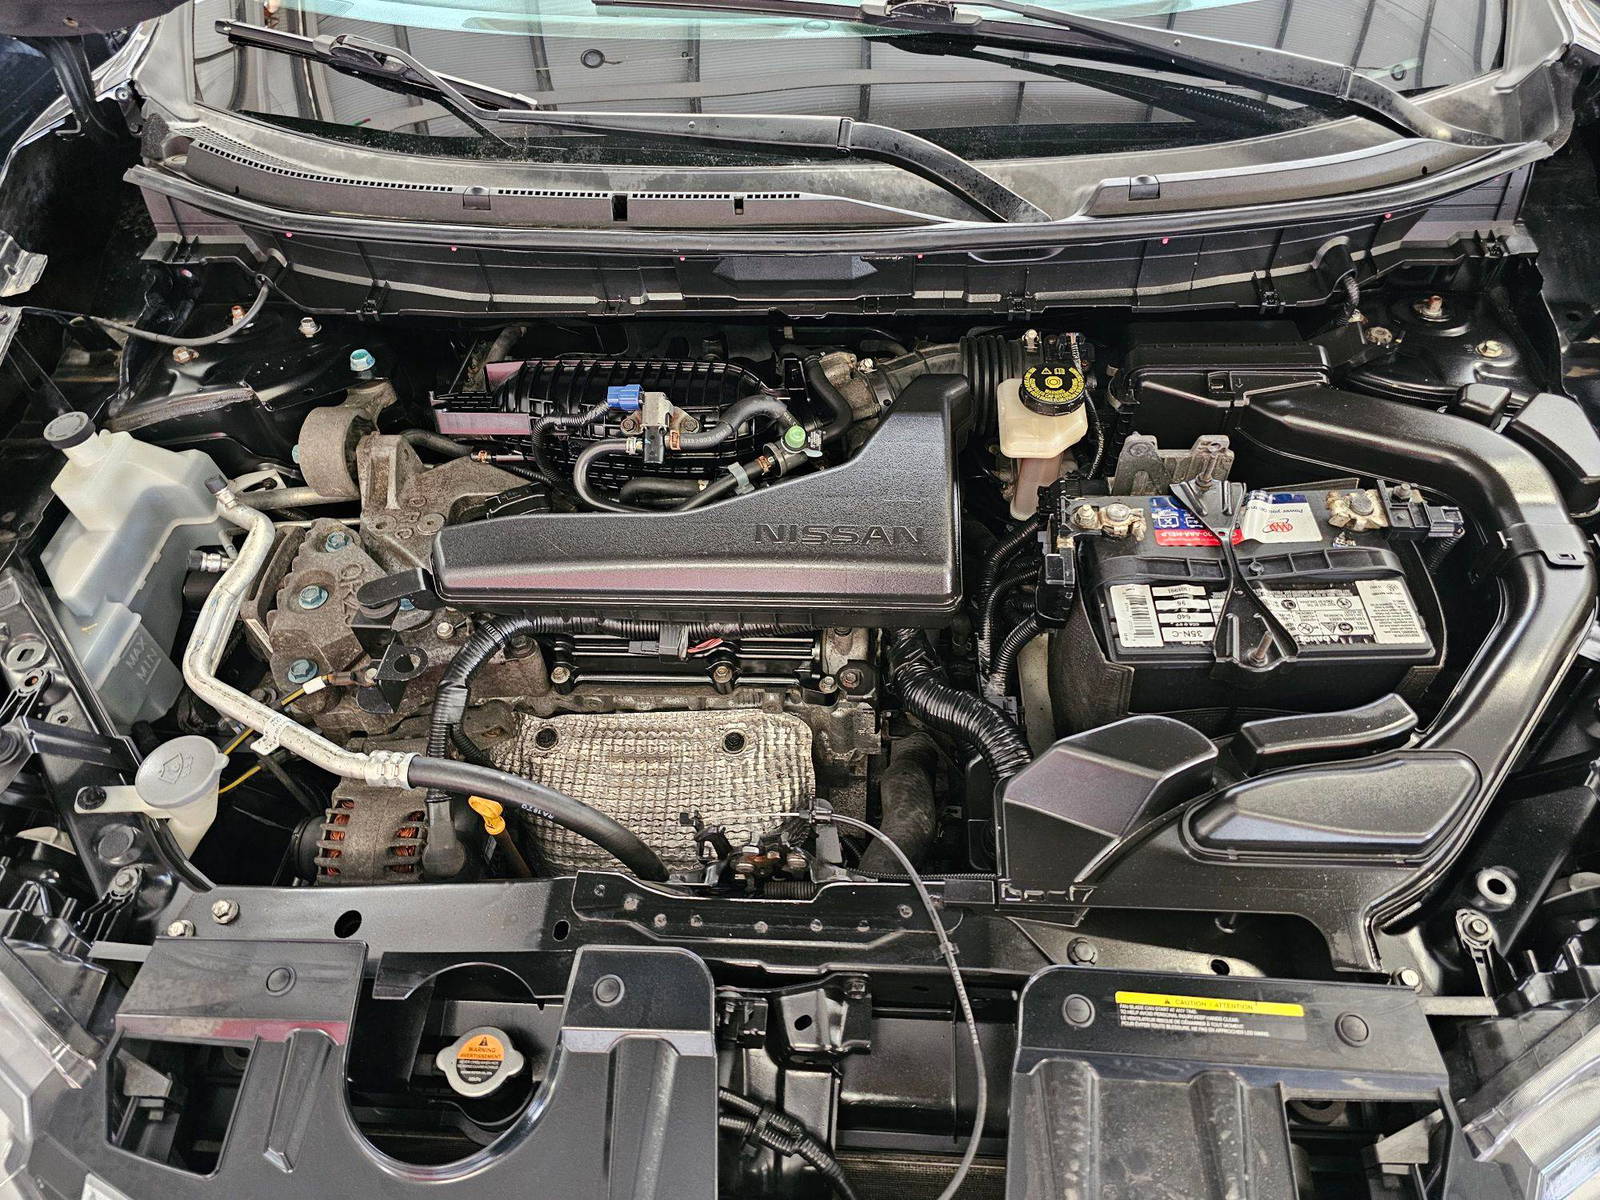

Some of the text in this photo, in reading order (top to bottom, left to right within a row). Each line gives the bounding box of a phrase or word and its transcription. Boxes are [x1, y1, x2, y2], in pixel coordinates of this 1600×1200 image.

[755, 523, 924, 546] NISSAN
[1172, 630, 1204, 638] 35N-C
[126, 635, 149, 669] MAX
[136, 647, 158, 681] MIN
[1175, 999, 1206, 1007] CAUTION
[1213, 1001, 1254, 1010] ATTENTION
